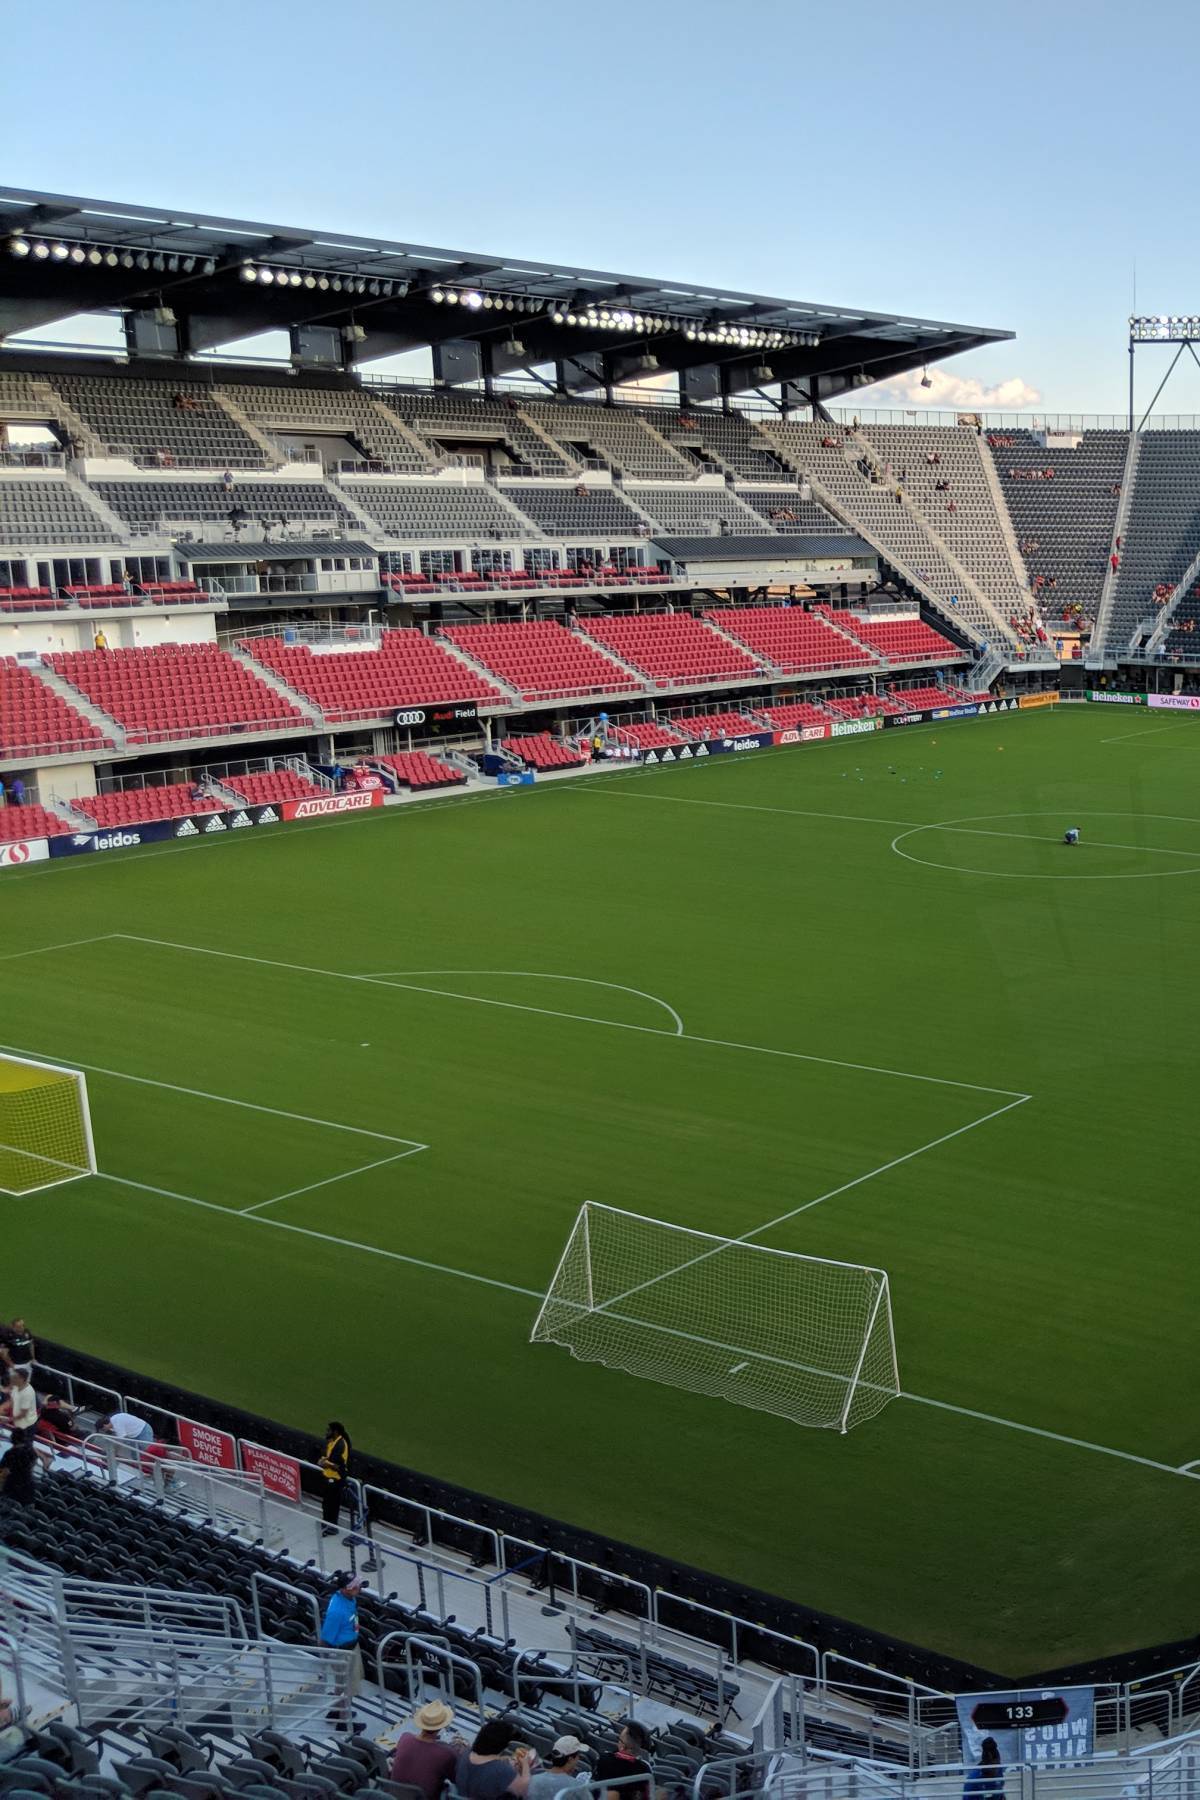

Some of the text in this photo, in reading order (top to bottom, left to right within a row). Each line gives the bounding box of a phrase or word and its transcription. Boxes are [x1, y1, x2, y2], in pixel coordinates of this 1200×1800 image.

[1092, 691, 1133, 703] Heineken
[1160, 697, 1190, 706] SAFEWAY
[455, 708, 476, 719] Field
[830, 718, 875, 737] Heineken
[734, 738, 760, 750] leidos
[295, 793, 373, 816] ADVOCARE
[94, 831, 141, 850] leidos
[192, 1428, 222, 1446] SMOKE
[193, 1440, 222, 1457] DEVICE
[199, 1452, 221, 1466] AREA
[425, 1651, 441, 1665] 134
[1006, 1705, 1034, 1720] 133
